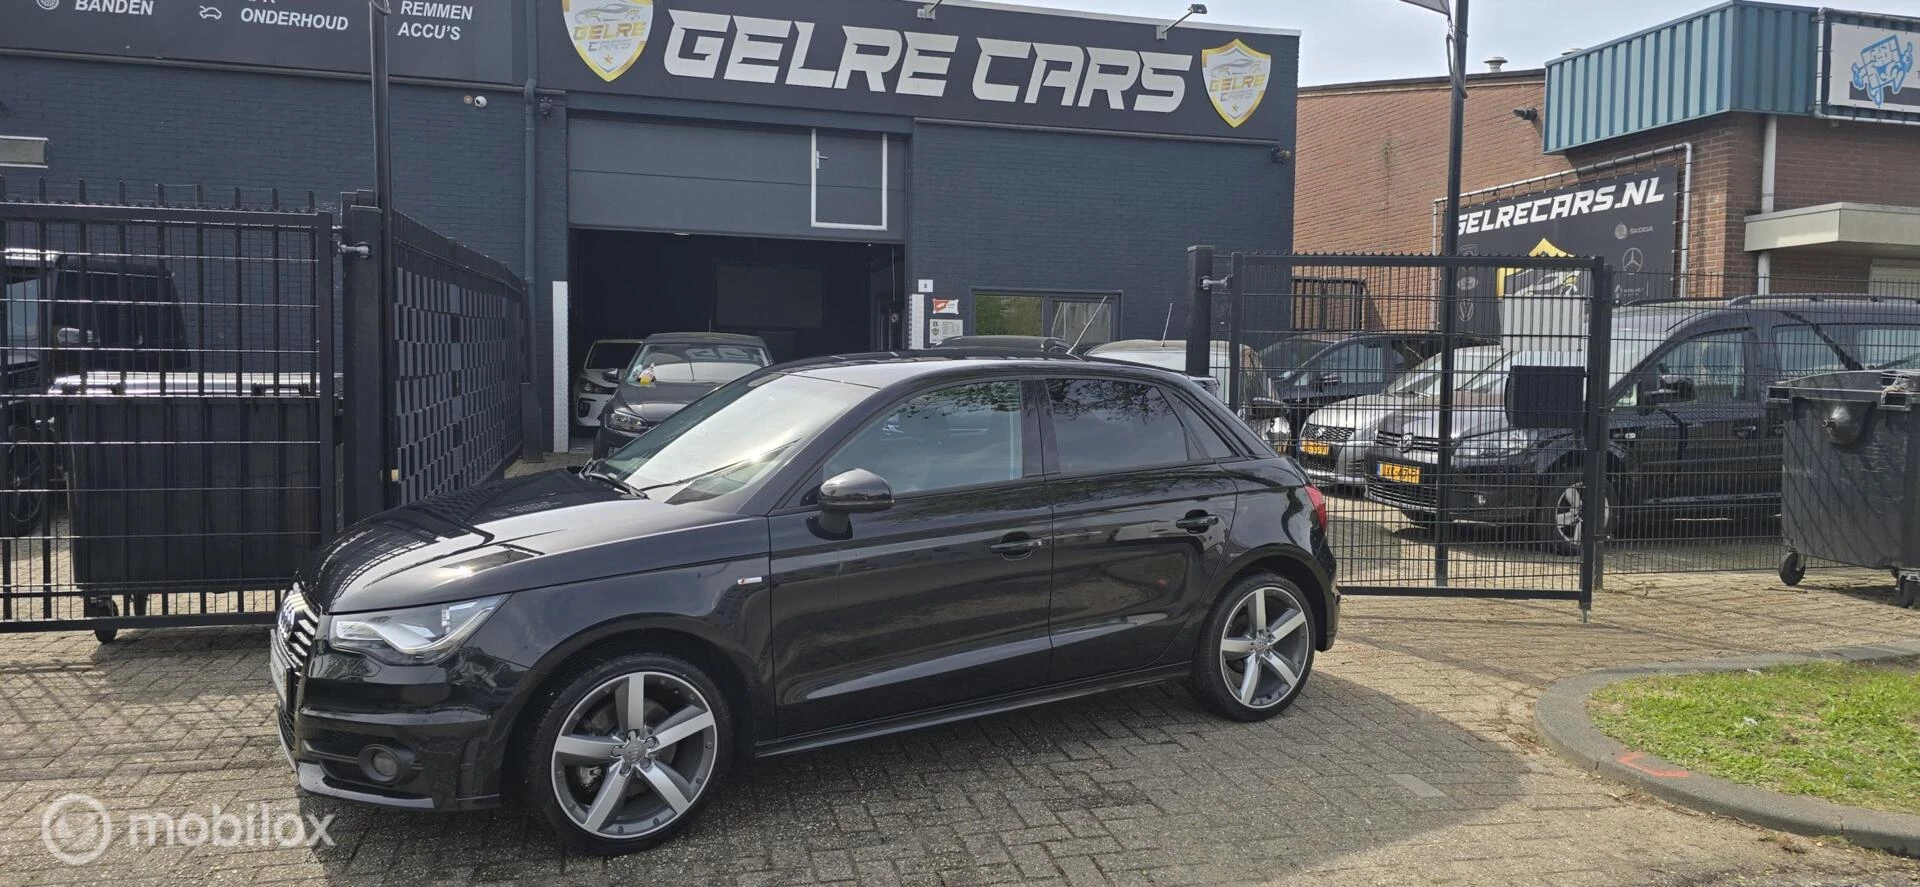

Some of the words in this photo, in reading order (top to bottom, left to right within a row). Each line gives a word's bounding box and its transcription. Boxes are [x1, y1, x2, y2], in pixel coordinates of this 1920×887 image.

[75, 0, 154, 15] BANDEN
[400, 0, 473, 20] REMMEN
[241, 7, 349, 31] ONDERHOUD
[397, 21, 461, 41] ACCU'S
[573, 22, 647, 40] GELRE
[588, 40, 631, 52] CARS
[663, 9, 959, 97] GELRE
[972, 37, 1193, 113] CARS
[1209, 73, 1266, 92] GELRE
